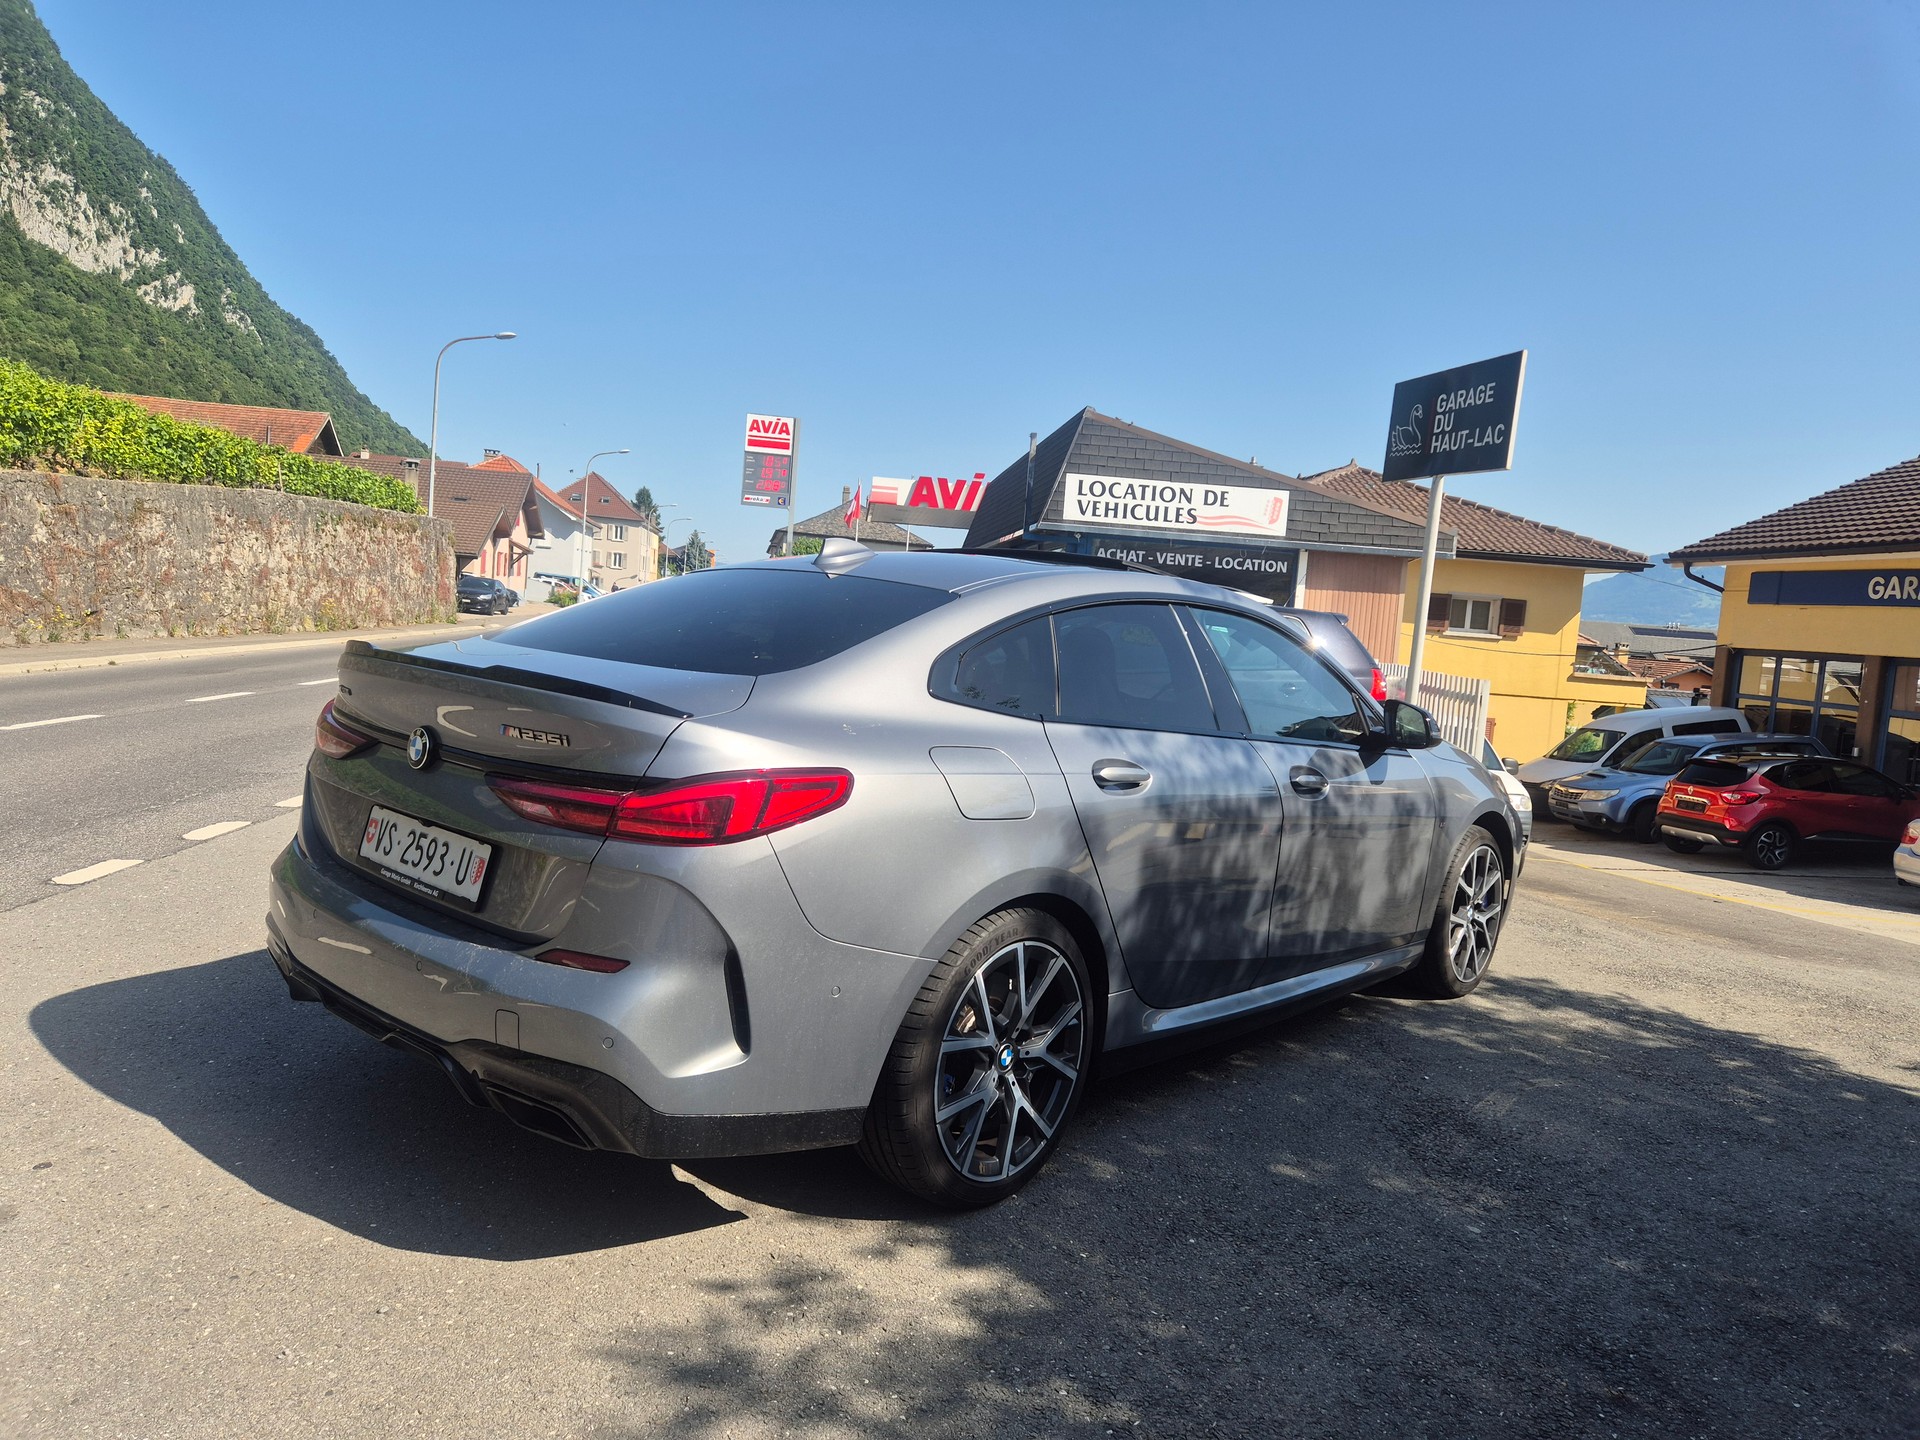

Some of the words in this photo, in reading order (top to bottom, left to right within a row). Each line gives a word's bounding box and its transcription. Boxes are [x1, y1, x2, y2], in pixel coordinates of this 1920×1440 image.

[1436, 382, 1496, 413] GARAGE
[1433, 412, 1455, 434] DU
[1430, 423, 1505, 454] HAUT-LAC
[909, 472, 991, 512] AVI
[1077, 479, 1193, 505] LOCATION
[1203, 489, 1230, 508] DE
[1076, 499, 1198, 525] VEHICULES
[1096, 547, 1146, 563] ACHAT
[1156, 552, 1203, 568] VENTE
[1214, 556, 1288, 574] LOCATION
[1867, 575, 1920, 600] GAR
[507, 725, 570, 747] M235i
